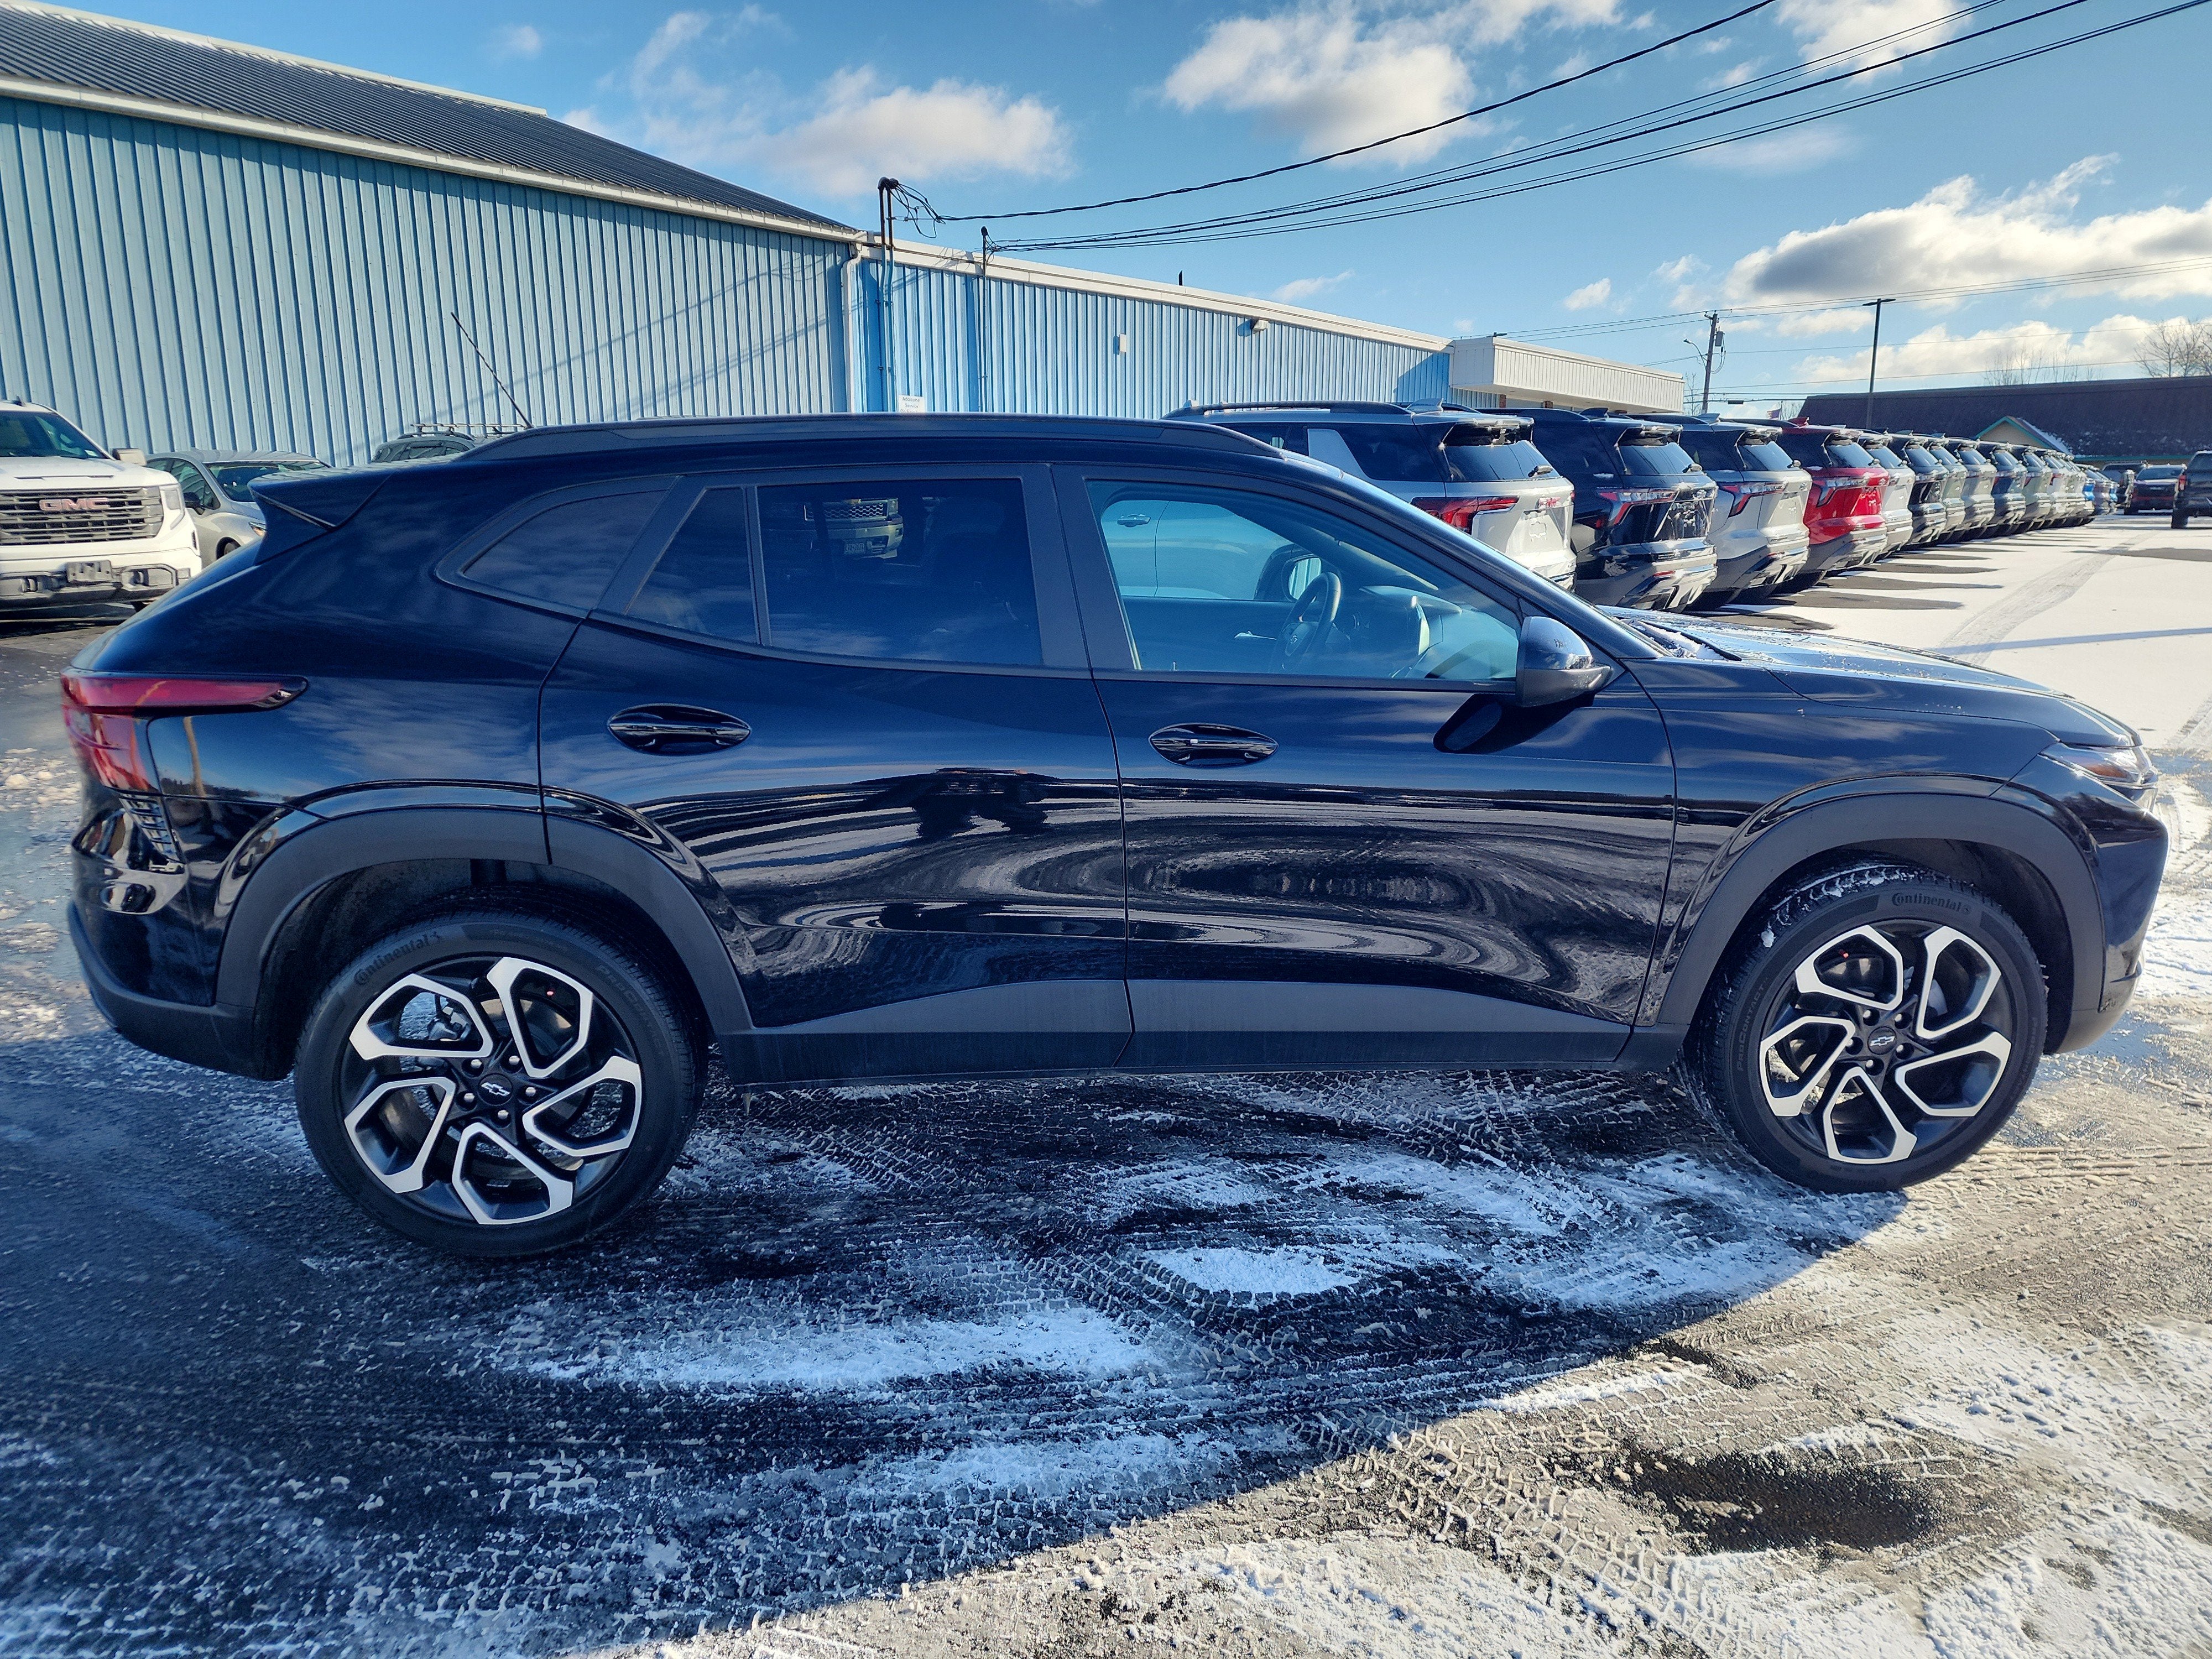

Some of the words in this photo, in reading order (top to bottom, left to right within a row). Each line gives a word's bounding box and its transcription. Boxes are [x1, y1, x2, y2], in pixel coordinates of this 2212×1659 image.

[39, 497, 110, 511] GMC
[1891, 893, 1962, 912] Continental
[354, 933, 431, 985] Continental
